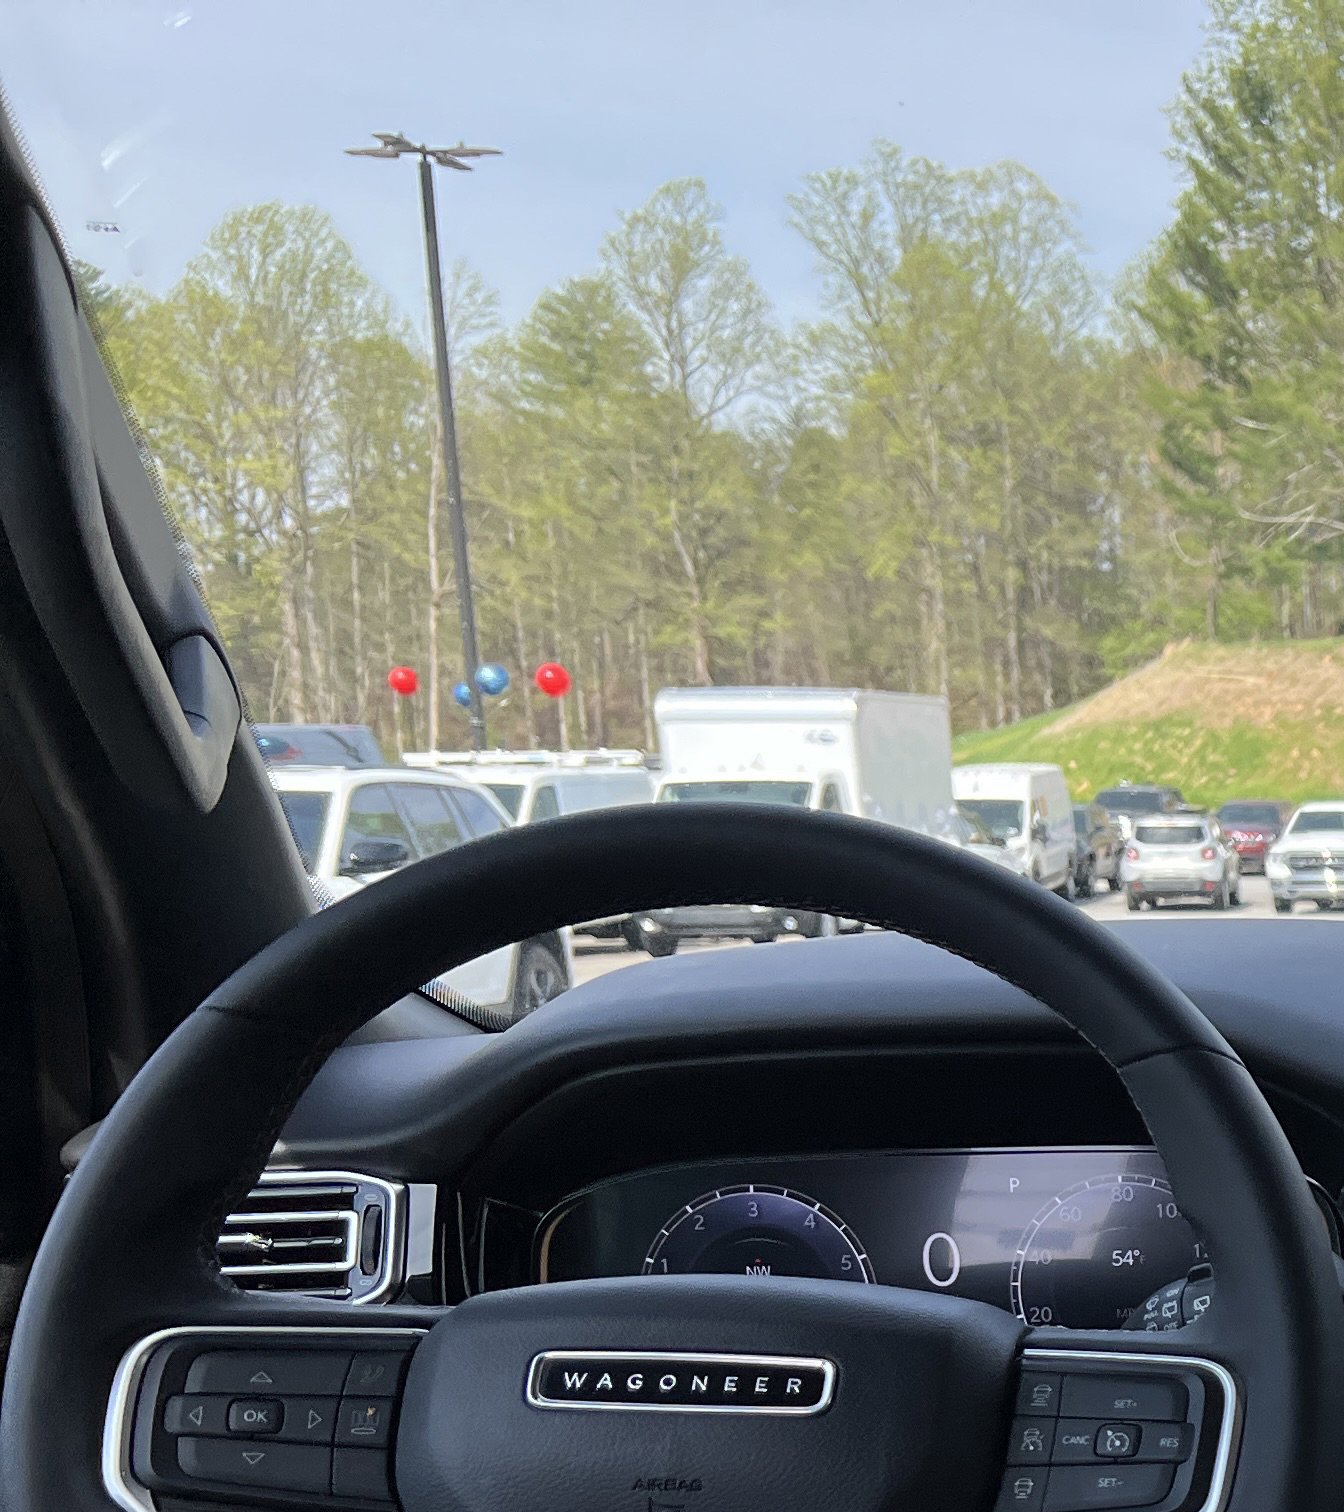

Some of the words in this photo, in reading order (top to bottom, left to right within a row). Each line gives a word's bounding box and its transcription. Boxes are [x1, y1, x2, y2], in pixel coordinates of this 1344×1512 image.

[1009, 1177, 1020, 1193] P
[1111, 1187, 1133, 1202] 80
[748, 1201, 758, 1217] 3
[1058, 1207, 1081, 1222] 60
[1156, 1203, 1181, 1218] 10
[694, 1214, 705, 1231] 2
[804, 1213, 816, 1229] 4
[841, 1254, 852, 1271] 5
[922, 1232, 961, 1287] 0
[1029, 1250, 1053, 1265] 40
[745, 1265, 771, 1277] NW
[1030, 1307, 1053, 1323] 20
[563, 1371, 802, 1394] WAGONEER
[243, 1409, 269, 1423] OK
[1062, 1434, 1090, 1445] CANC
[1159, 1438, 1180, 1448] RES
[631, 1478, 703, 1492] AIRBAG
